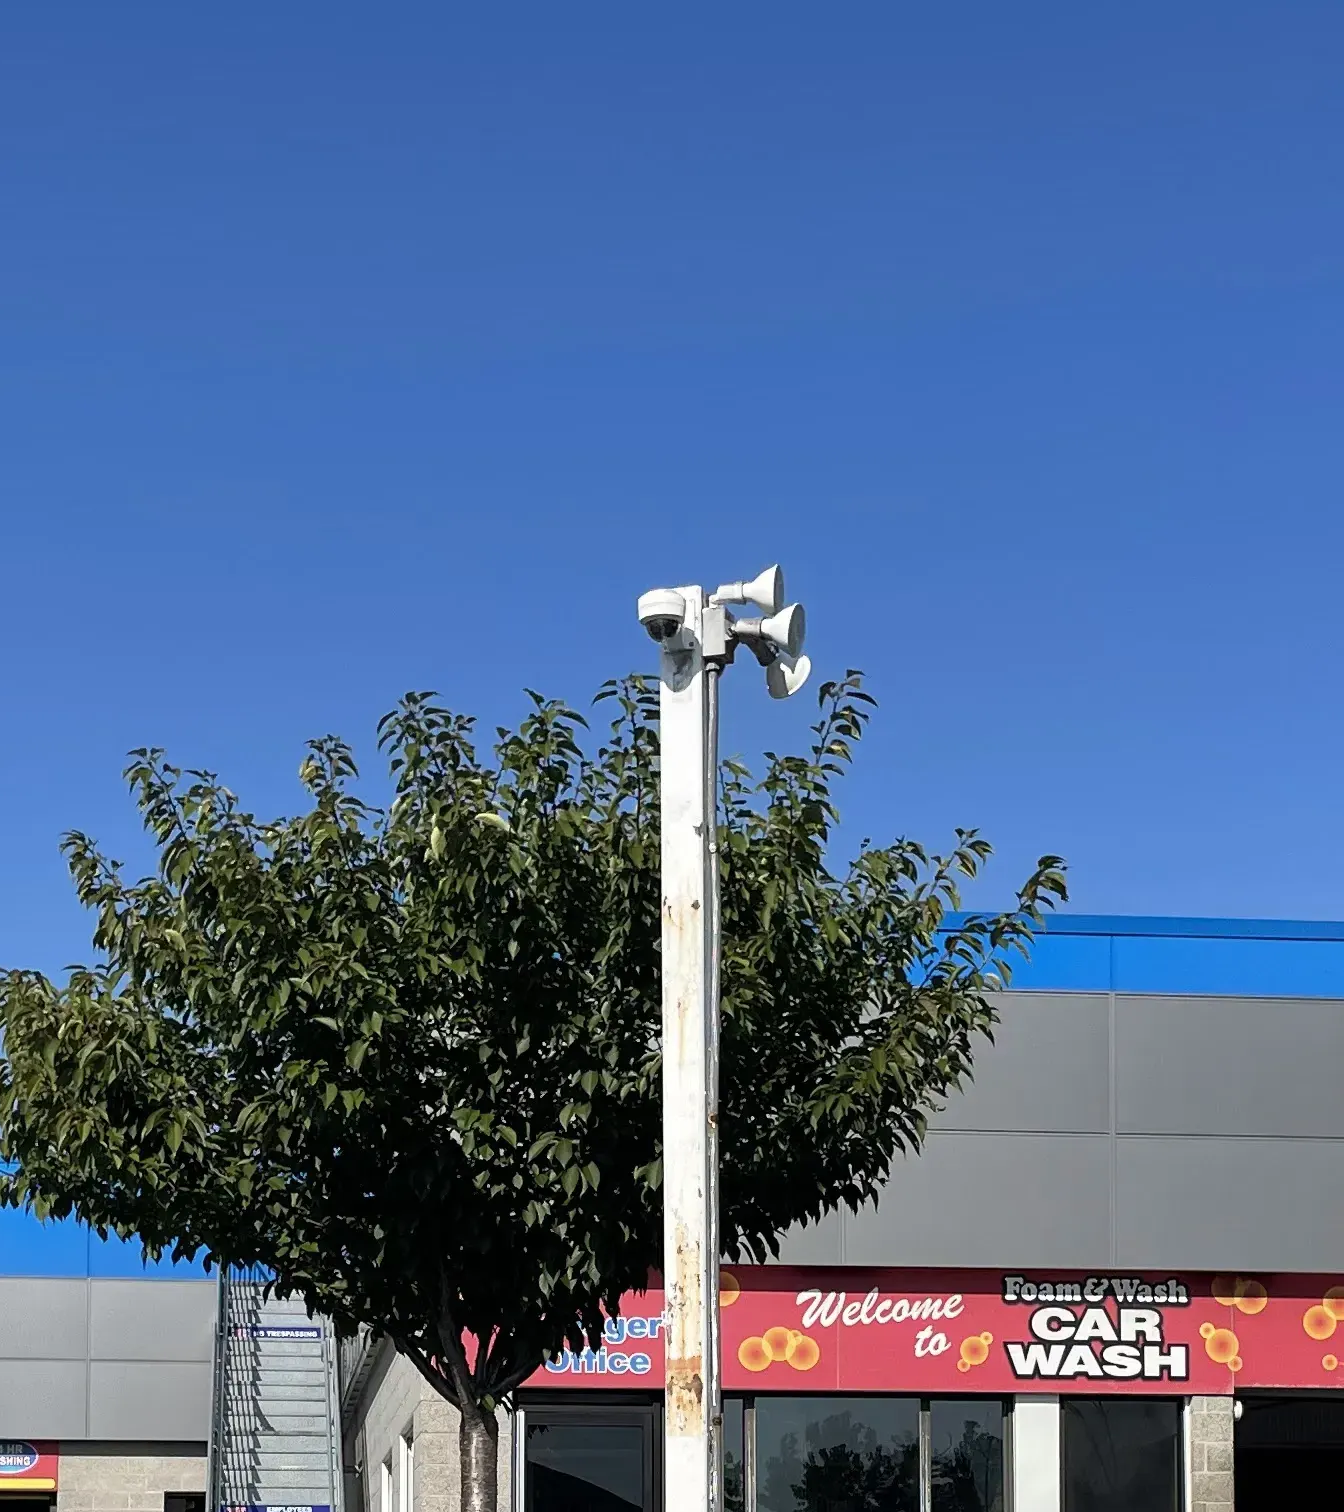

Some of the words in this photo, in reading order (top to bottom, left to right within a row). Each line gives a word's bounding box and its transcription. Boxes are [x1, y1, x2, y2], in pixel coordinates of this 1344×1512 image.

[795, 1286, 965, 1329] Welcome
[1030, 1306, 1162, 1342] CAR
[914, 1324, 952, 1358] to
[1006, 1343, 1188, 1378] WASH
[6, 1443, 23, 1455] HR
